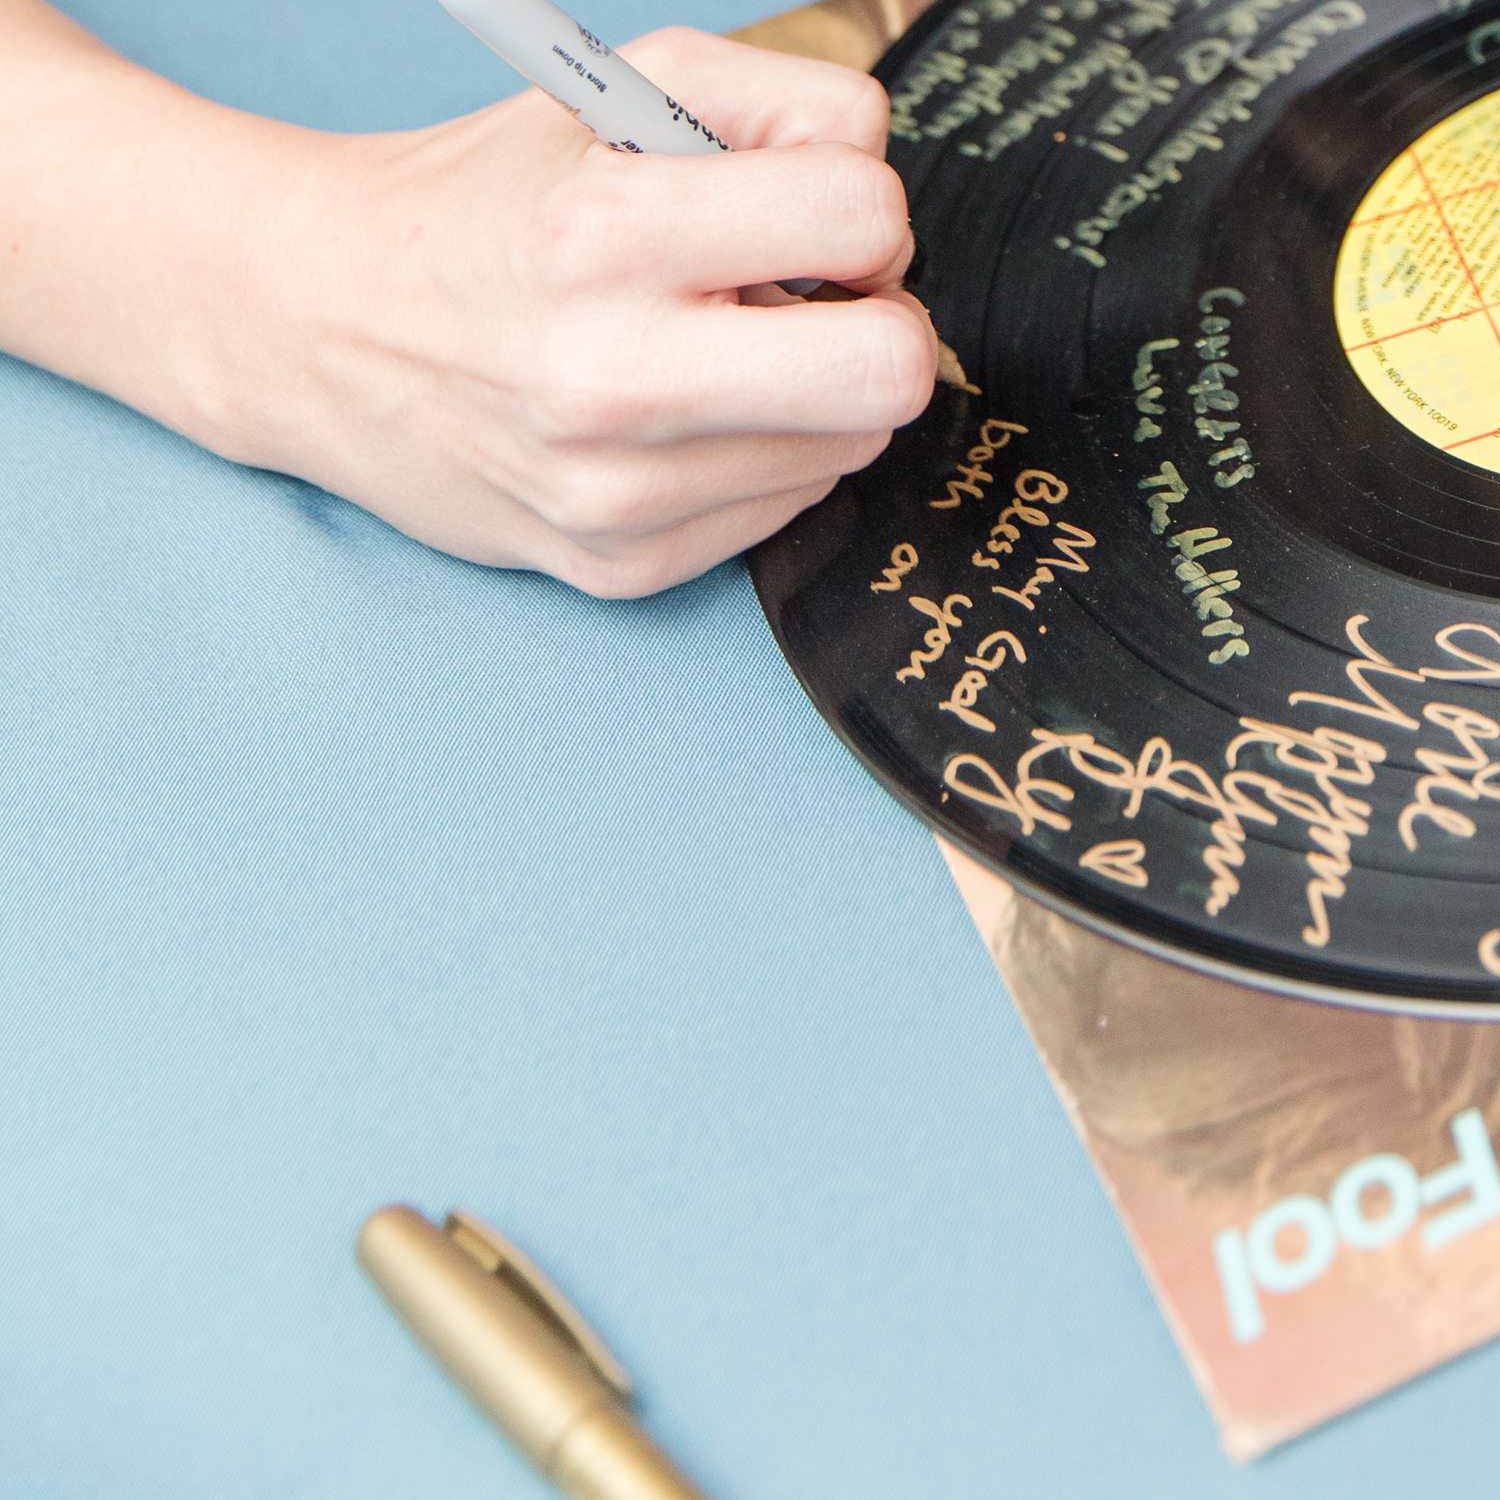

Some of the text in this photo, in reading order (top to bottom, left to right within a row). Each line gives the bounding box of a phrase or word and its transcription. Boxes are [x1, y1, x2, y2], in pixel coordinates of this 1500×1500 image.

[552, 44, 608, 94] Store Tip Down
[1133, 338, 1180, 442] Love
[1192, 288, 1255, 488] CONGRATS
[1398, 385, 1427, 408] YORK
[1425, 408, 1457, 430] 10019
[929, 418, 1029, 509] both
[896, 469, 1068, 683] Bless you
[938, 521, 1097, 733] May God
